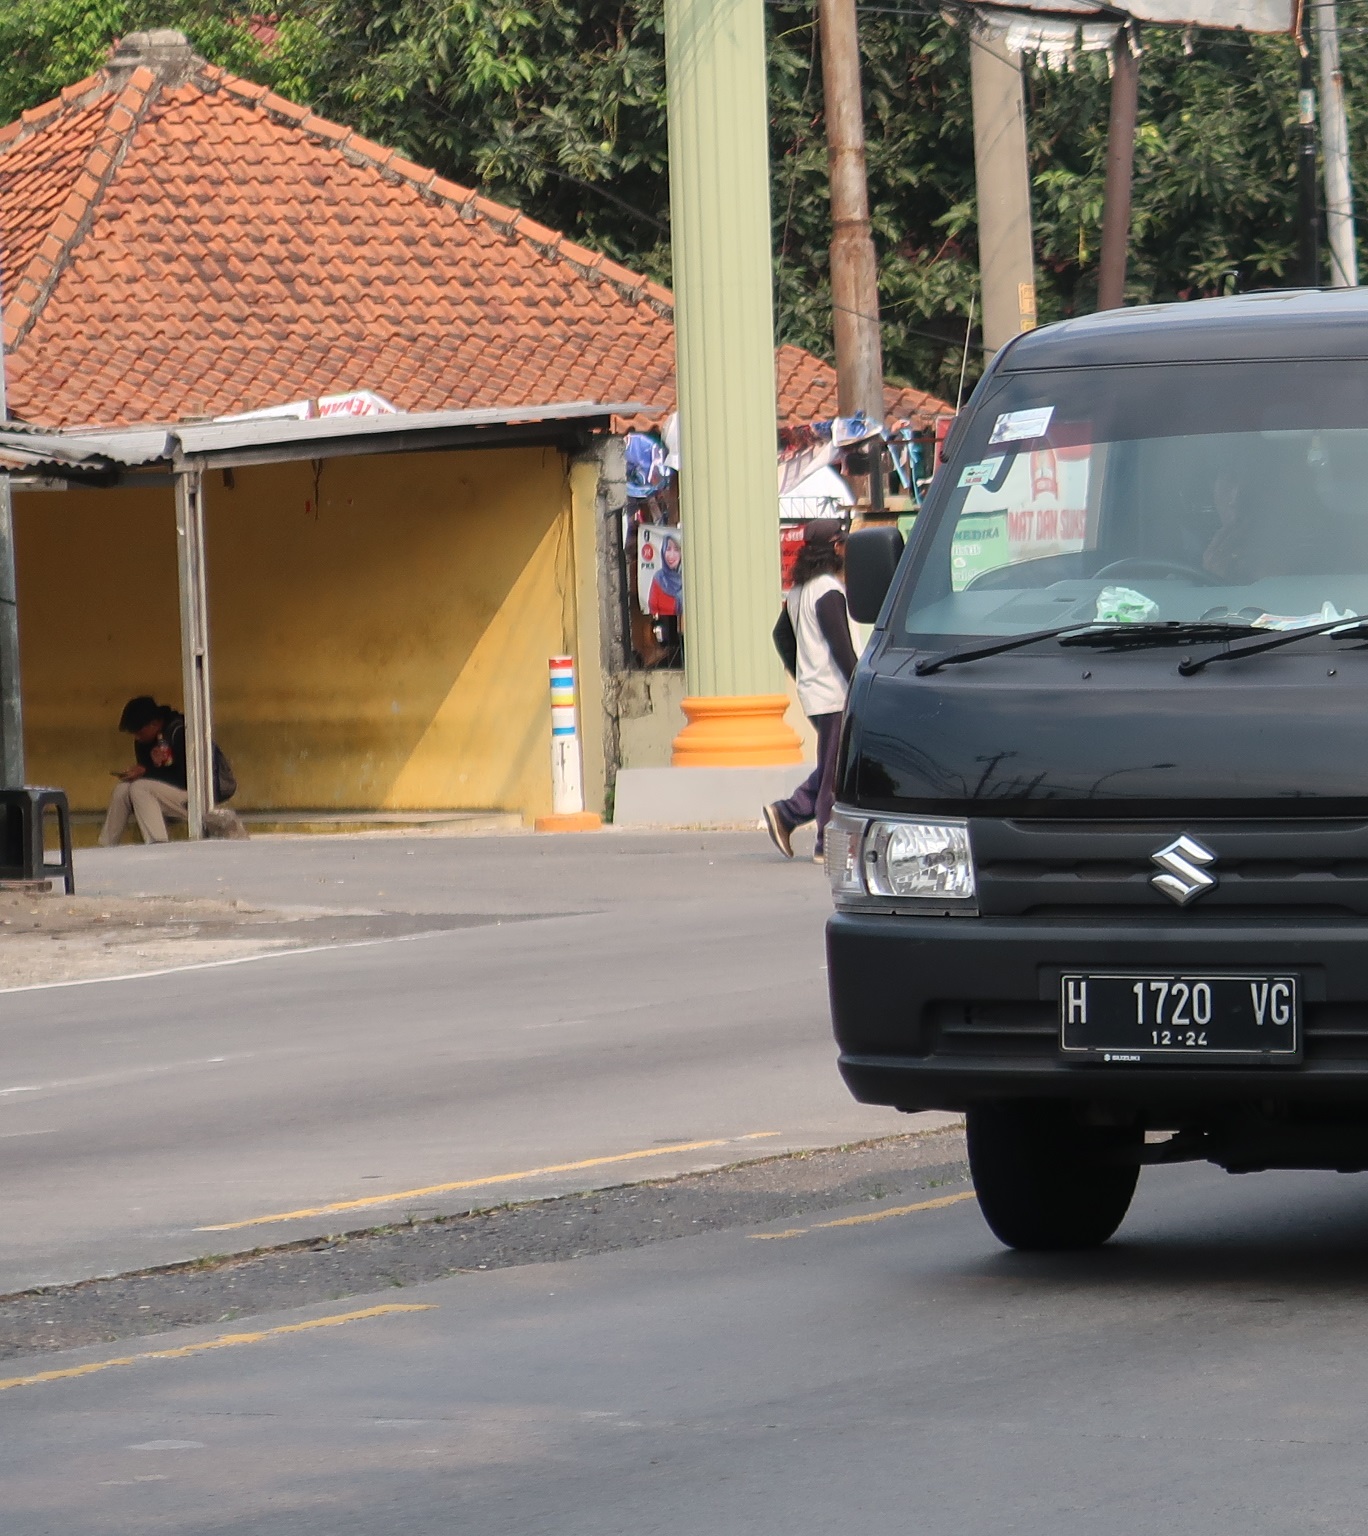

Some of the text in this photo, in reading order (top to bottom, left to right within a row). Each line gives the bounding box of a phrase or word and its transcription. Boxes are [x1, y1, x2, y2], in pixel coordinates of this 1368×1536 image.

[1068, 981, 1289, 1026] H 1720 VG
